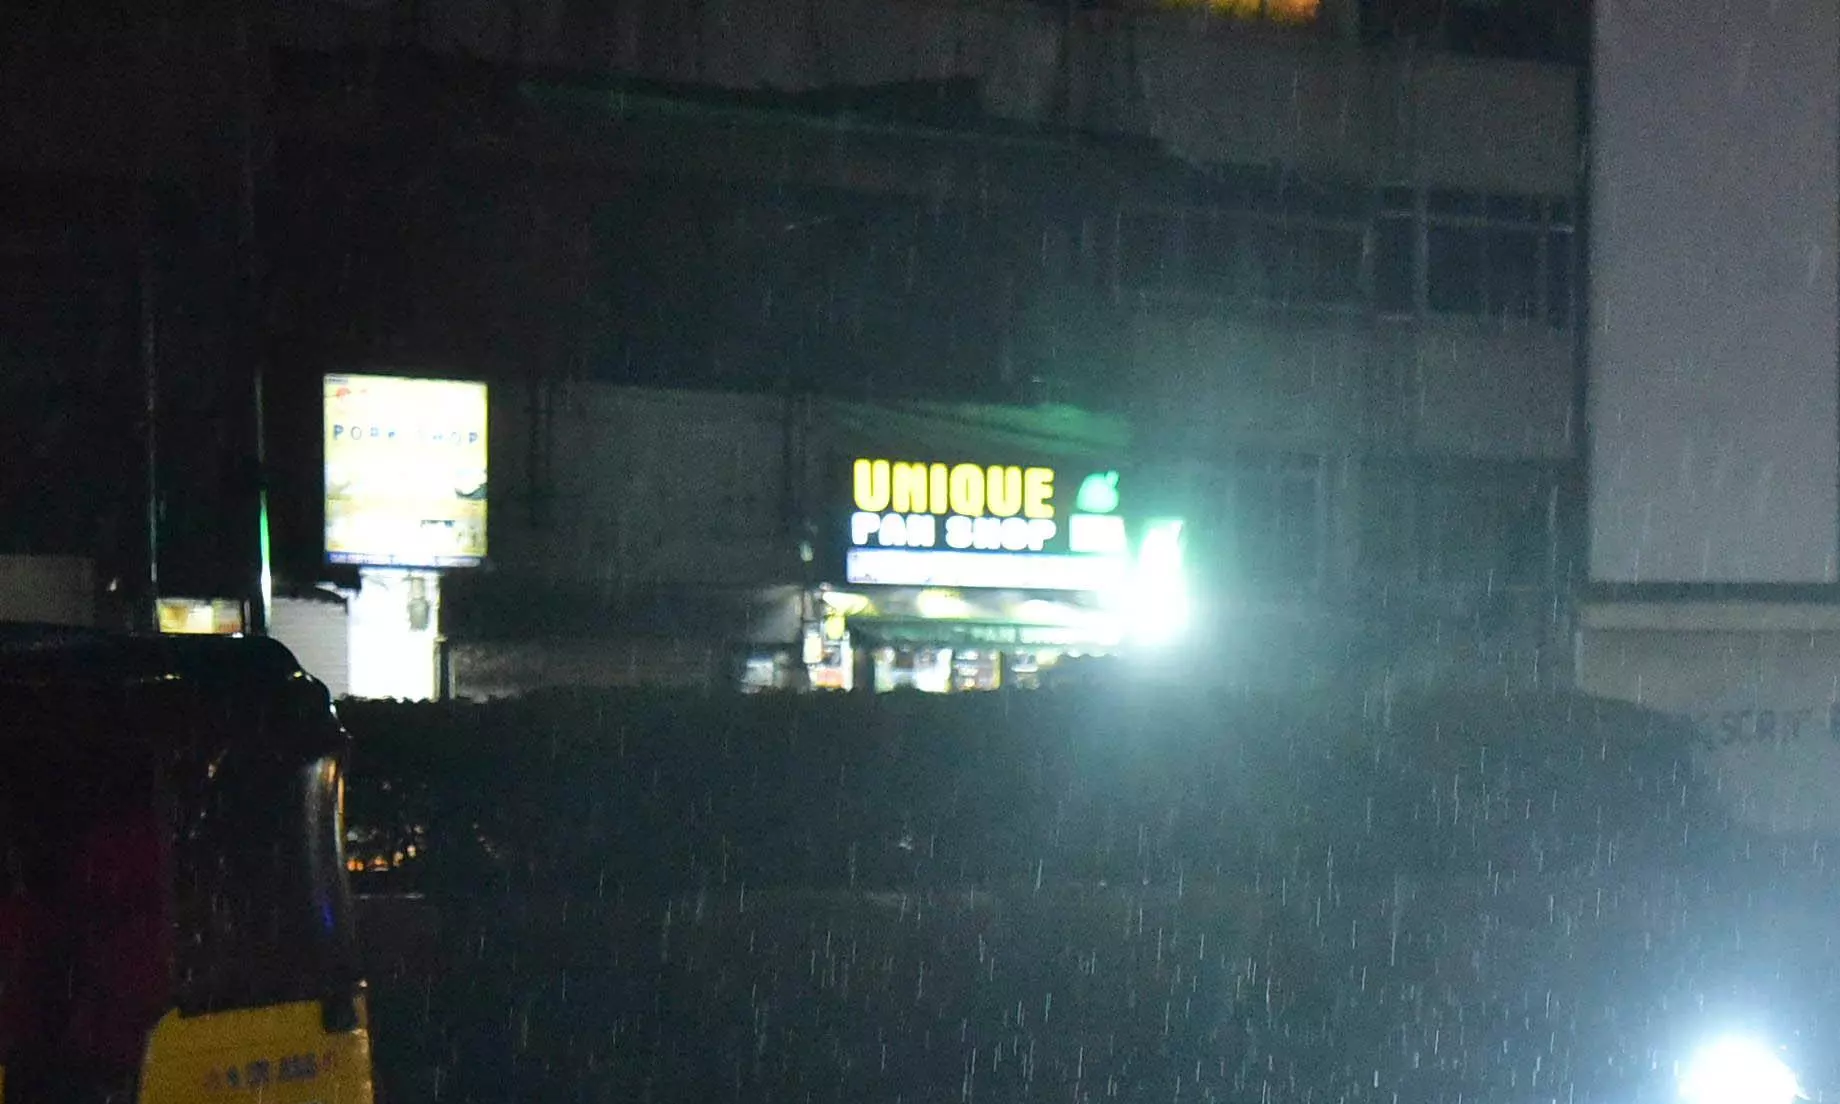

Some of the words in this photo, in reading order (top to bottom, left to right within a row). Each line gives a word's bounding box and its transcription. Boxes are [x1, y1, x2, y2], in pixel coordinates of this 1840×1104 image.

[853, 459, 1055, 518] UNIQUE
[851, 512, 936, 546] PAN
[945, 515, 1056, 551] SHOP
